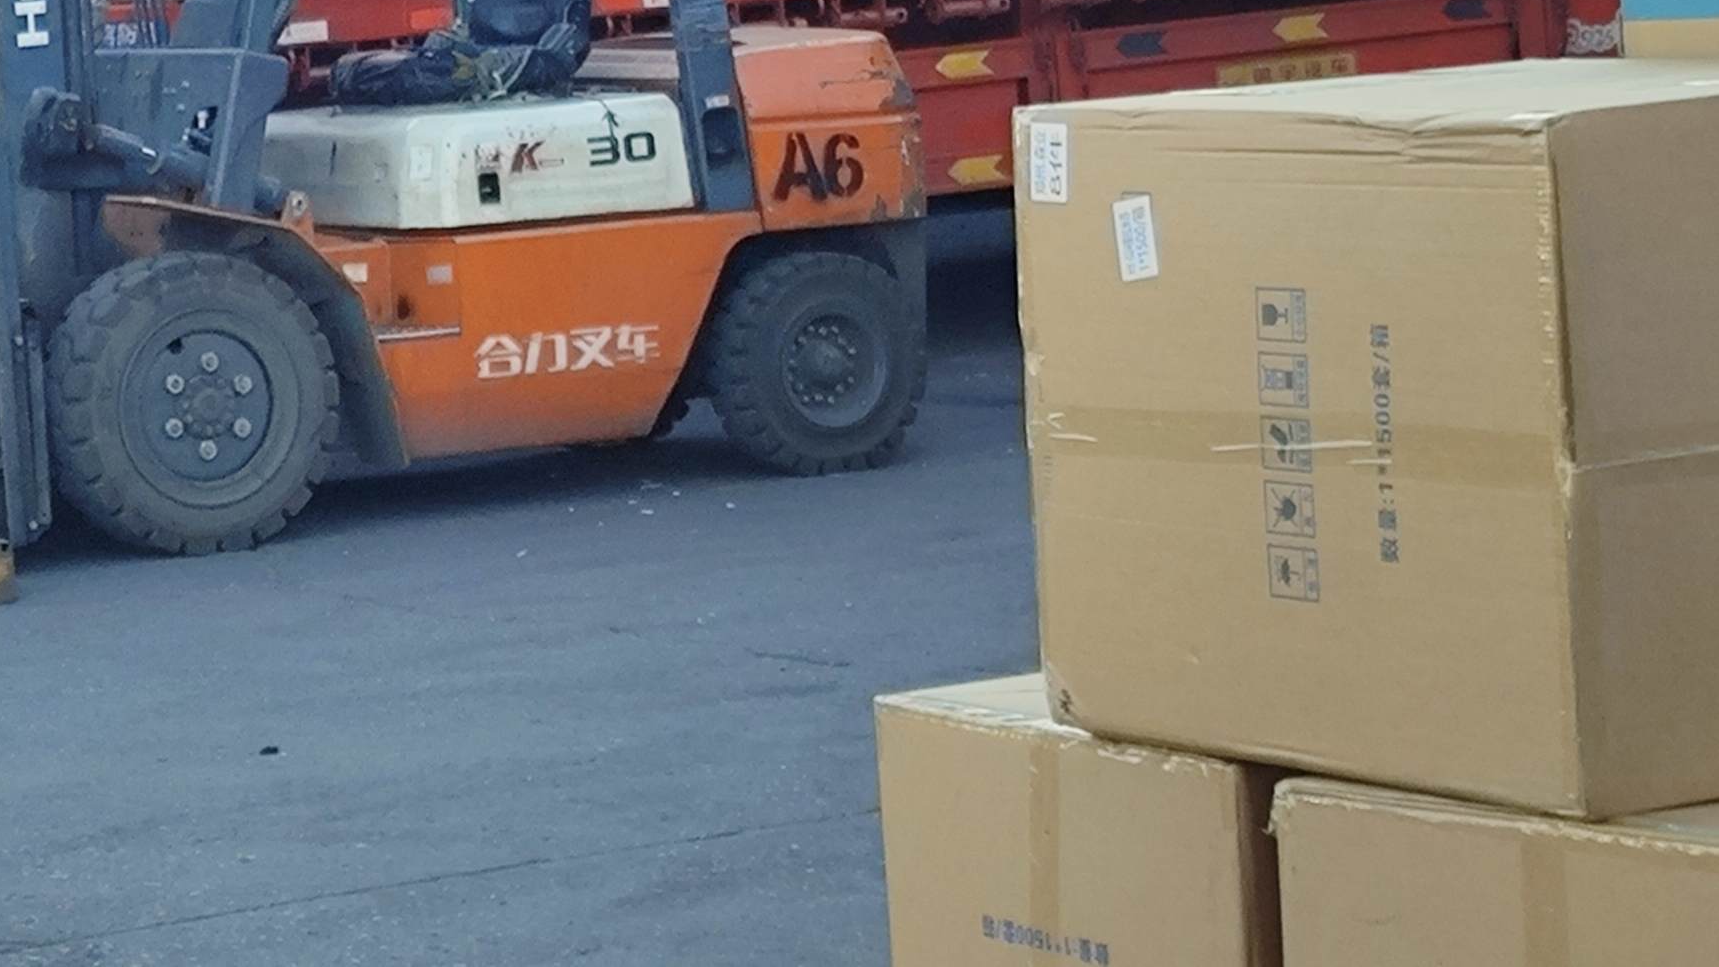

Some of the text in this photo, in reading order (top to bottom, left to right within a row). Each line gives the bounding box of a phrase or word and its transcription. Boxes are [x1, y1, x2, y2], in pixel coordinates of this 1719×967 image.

[587, 131, 657, 168] 30
[773, 132, 865, 203] A6
[475, 323, 661, 381] 合力叉车
